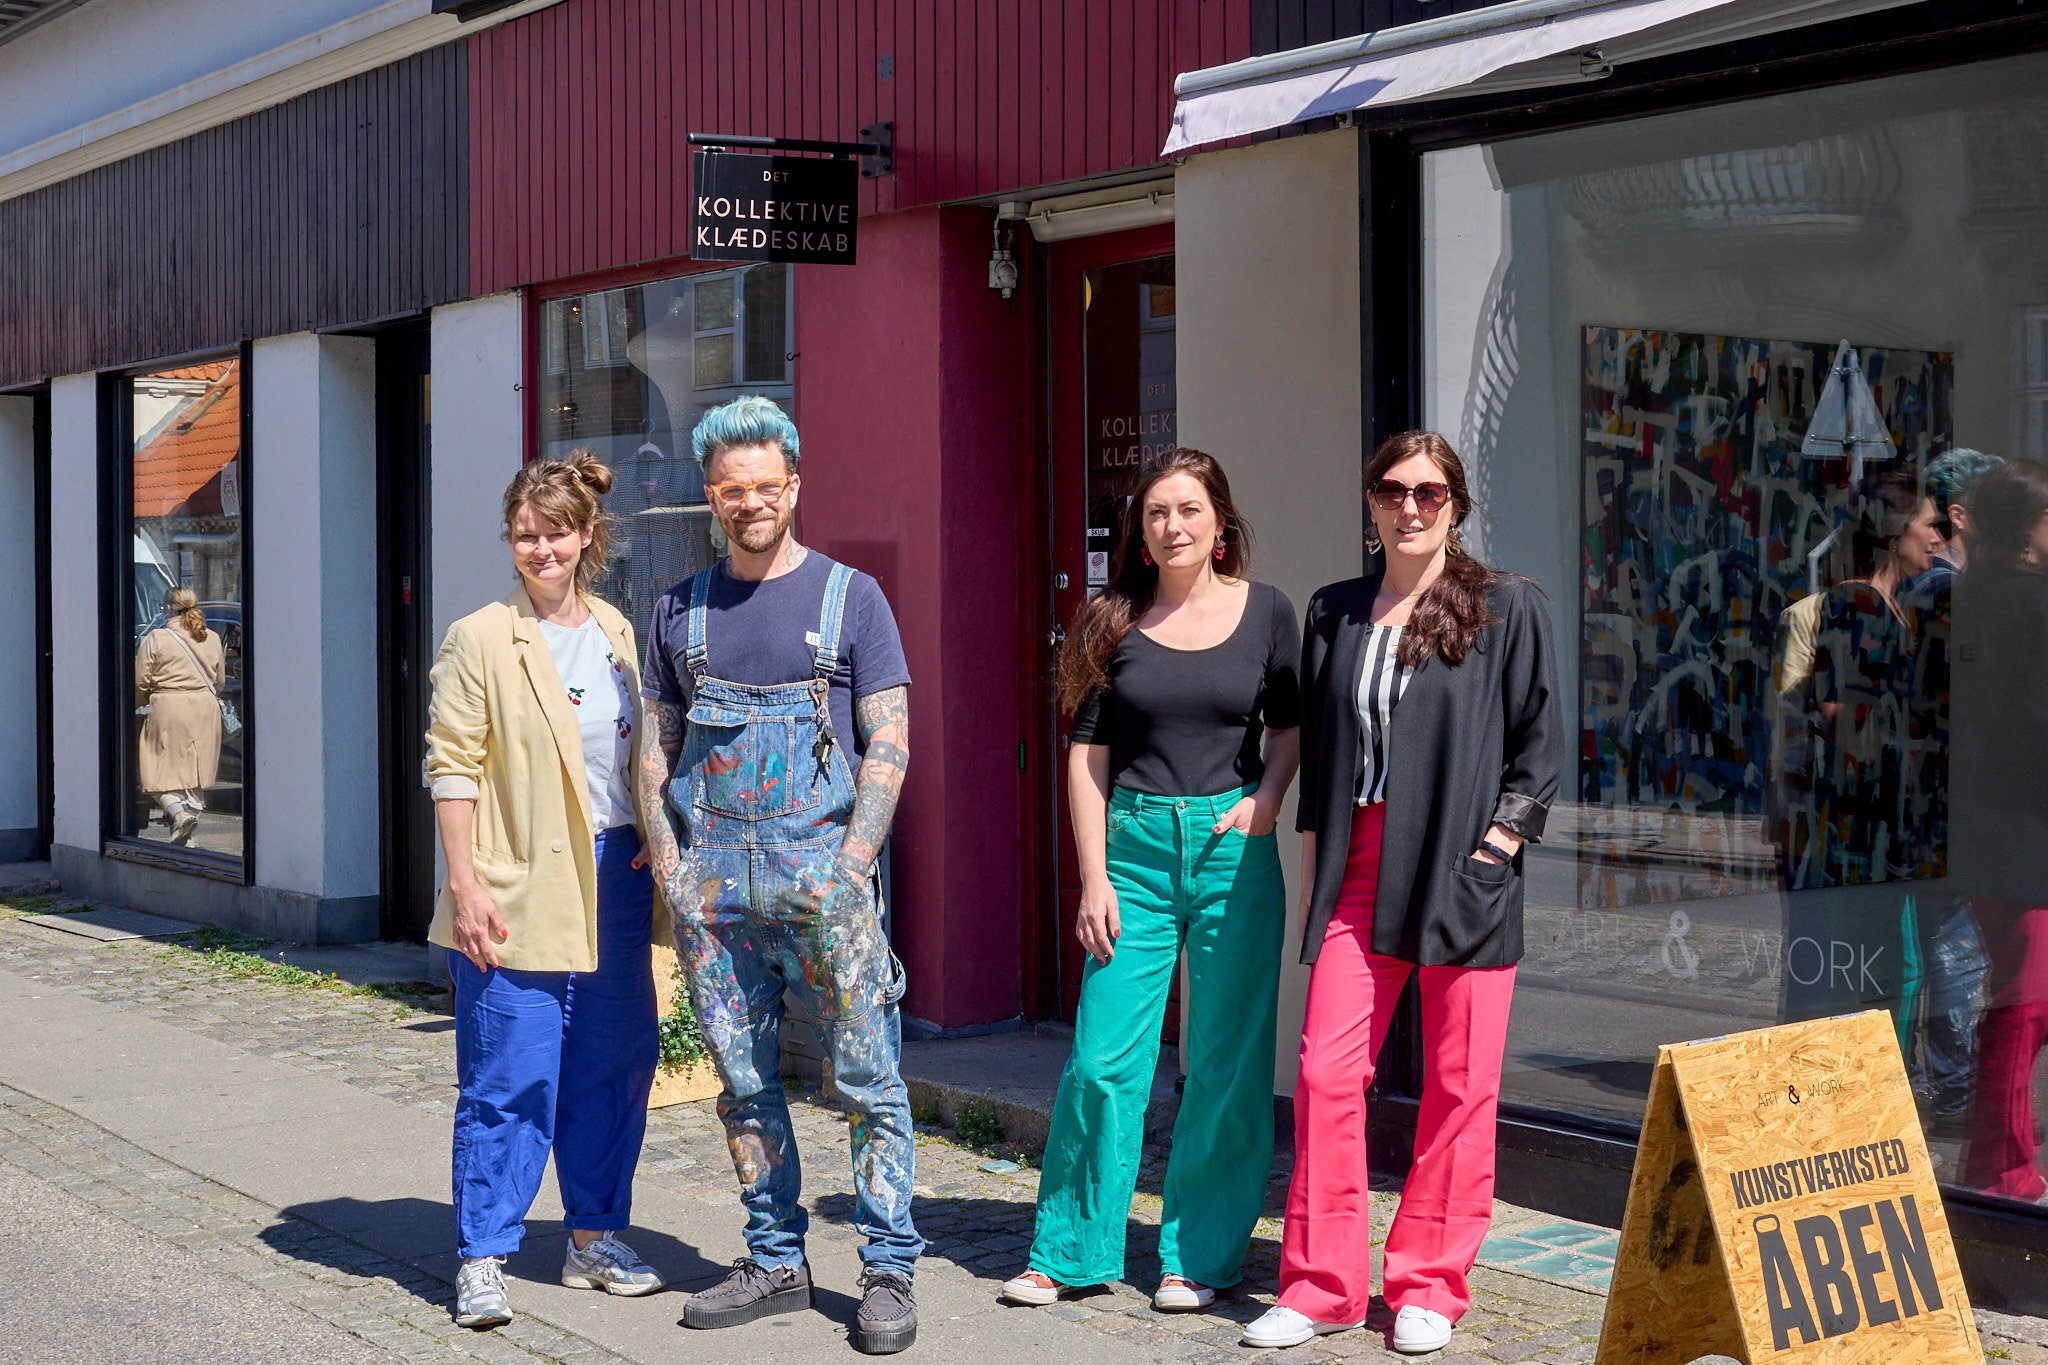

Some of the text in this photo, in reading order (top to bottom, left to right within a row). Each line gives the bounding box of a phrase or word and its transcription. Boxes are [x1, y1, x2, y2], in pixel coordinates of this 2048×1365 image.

[763, 170, 790, 183] DET
[698, 196, 850, 224] KOLLEKTIVE
[697, 226, 848, 252] KLÆDESKAB
[1147, 383, 1168, 396] DET
[1102, 412, 1177, 438] KOLLEK
[1661, 910, 1699, 980] &
[1740, 929, 1885, 995] WORK
[1757, 1079, 1847, 1108] ART & WORK
[1730, 1138, 1910, 1209] KUNSTVÆRKSTED
[1753, 1194, 1944, 1352] ÅBEN
